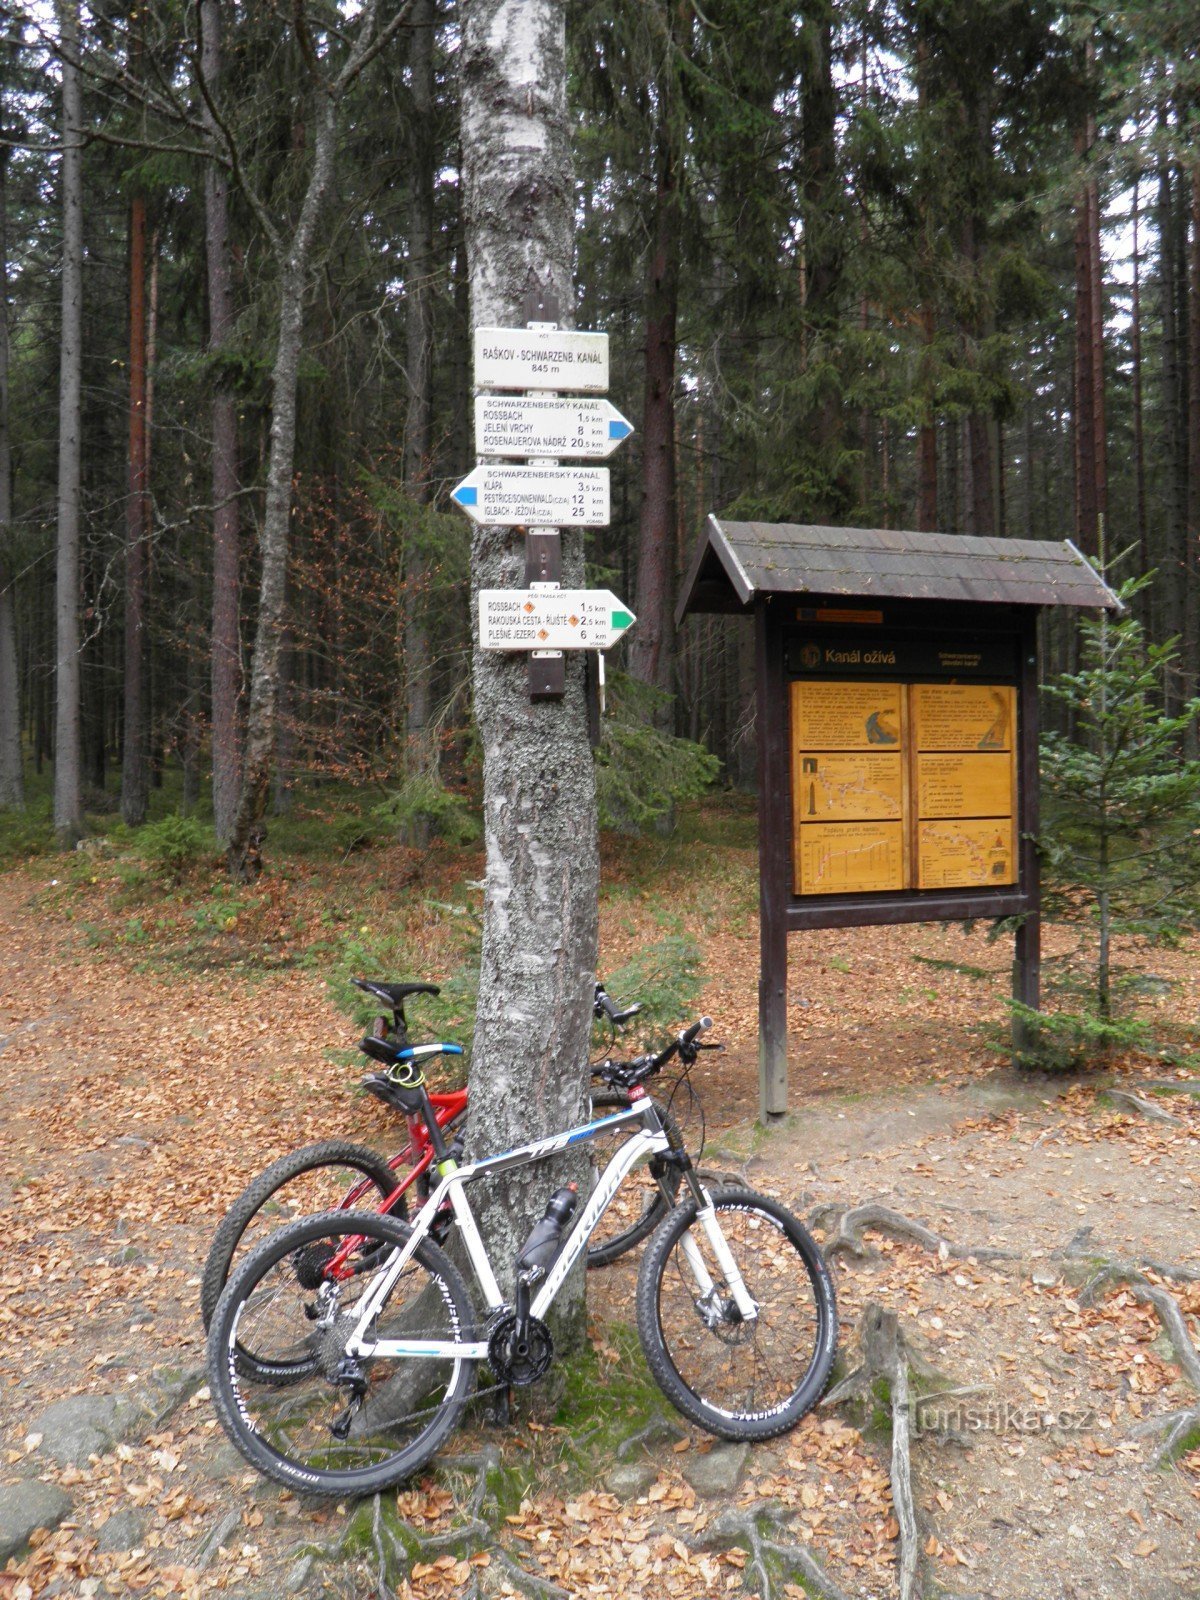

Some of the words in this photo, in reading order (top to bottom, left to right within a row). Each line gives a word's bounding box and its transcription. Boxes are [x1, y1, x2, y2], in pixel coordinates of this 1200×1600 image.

[482, 346, 515, 360] RAŠKOV
[520, 349, 576, 363] SCHWARZENB.
[577, 351, 602, 365] KANÁL
[531, 364, 549, 373] 845
[551, 366, 560, 374] m
[487, 399, 571, 410] SCHWARZENBERSKÝ
[572, 402, 600, 411] KANÁL
[483, 411, 523, 421] ROSSBACH
[591, 415, 603, 423] km
[484, 423, 508, 433] JELENÍ
[510, 424, 534, 434] VRCHY
[577, 426, 584, 435] 8
[592, 428, 603, 436] km
[484, 436, 541, 446] ROSENAUEROVA
[543, 436, 567, 447] NÁDRŽ
[487, 470, 571, 479] SCHWARZENBERSKÝ
[573, 470, 600, 480] KANÁL
[483, 480, 503, 490] KLÁPA
[572, 495, 585, 504] 12
[593, 497, 604, 505] km
[484, 506, 510, 516] IGLBACH
[572, 507, 585, 517] 25
[488, 601, 521, 611] ROSSBACH
[488, 613, 521, 625] RAKOUSKÁ
[522, 616, 541, 625] CESTA
[594, 618, 606, 626] km
[488, 628, 511, 639] PLEŠNÉ
[513, 630, 536, 639] JEZERO
[580, 630, 587, 640] 6
[825, 648, 860, 663] Kanál
[863, 650, 896, 665] ožívá
